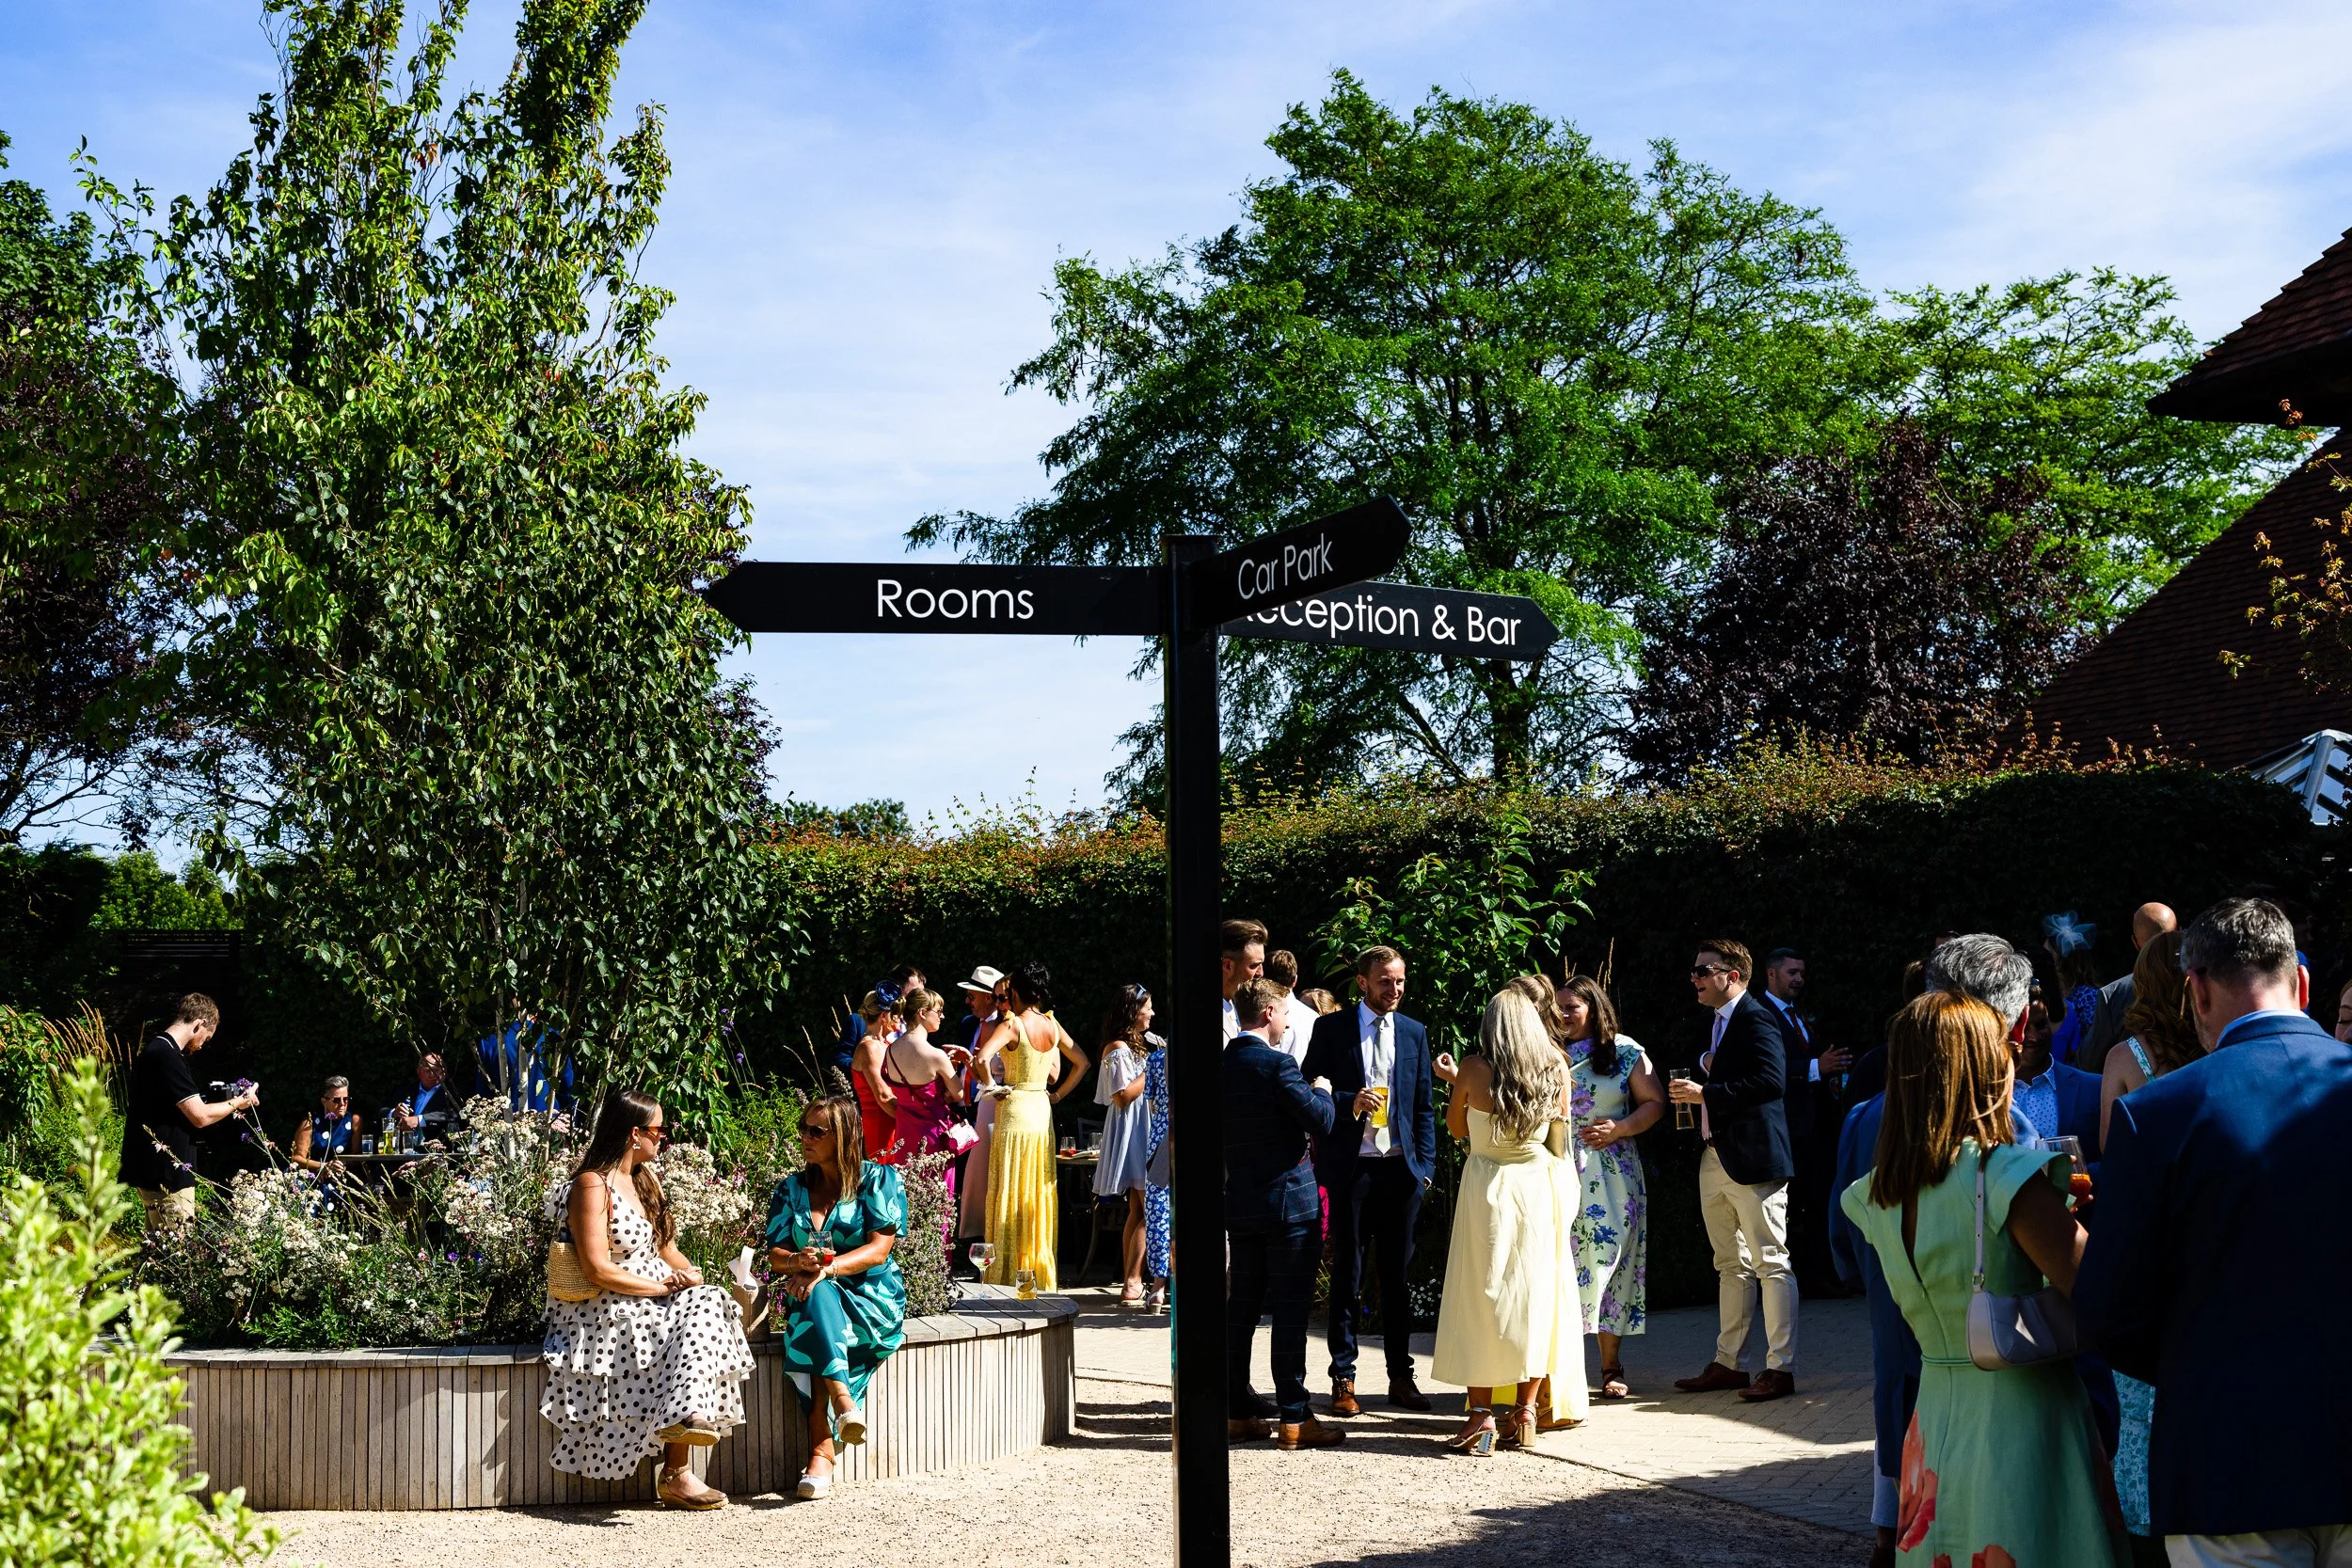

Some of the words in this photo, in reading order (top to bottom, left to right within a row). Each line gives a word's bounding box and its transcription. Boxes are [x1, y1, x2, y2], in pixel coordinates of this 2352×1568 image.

[1238, 559, 1279, 600] Car
[1284, 532, 1333, 586] Park
[877, 578, 1034, 620] Rooms
[1247, 594, 1420, 639] ception
[1431, 604, 1457, 641] &
[1467, 606, 1522, 646] Bar
